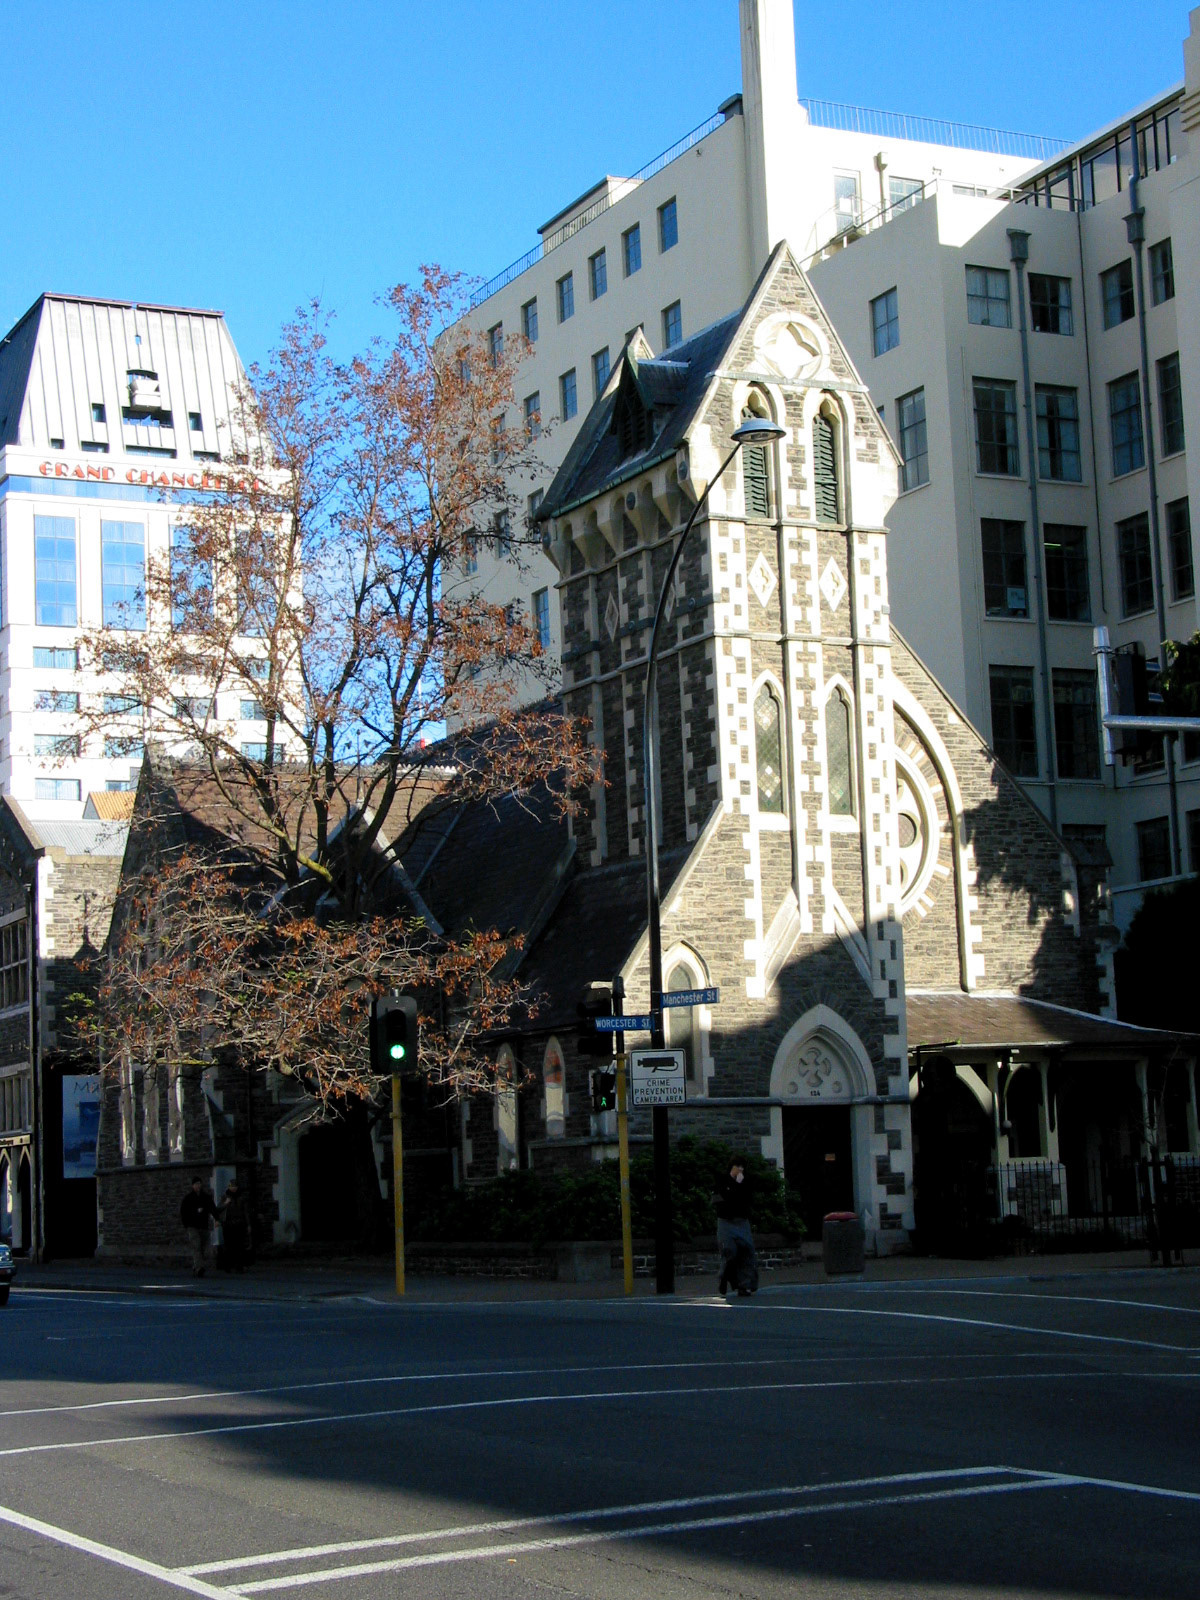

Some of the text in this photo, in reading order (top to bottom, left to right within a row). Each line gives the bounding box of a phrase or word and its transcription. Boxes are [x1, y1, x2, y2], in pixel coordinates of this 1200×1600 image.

[39, 461, 263, 491] GRAND CHANCEL
[663, 991, 715, 1005] Manchester St
[595, 1018, 637, 1029] WORCESTER
[647, 1079, 670, 1087] CRIME
[634, 1087, 683, 1095] PREVENTION
[635, 1095, 682, 1104] CAMERA AREA
